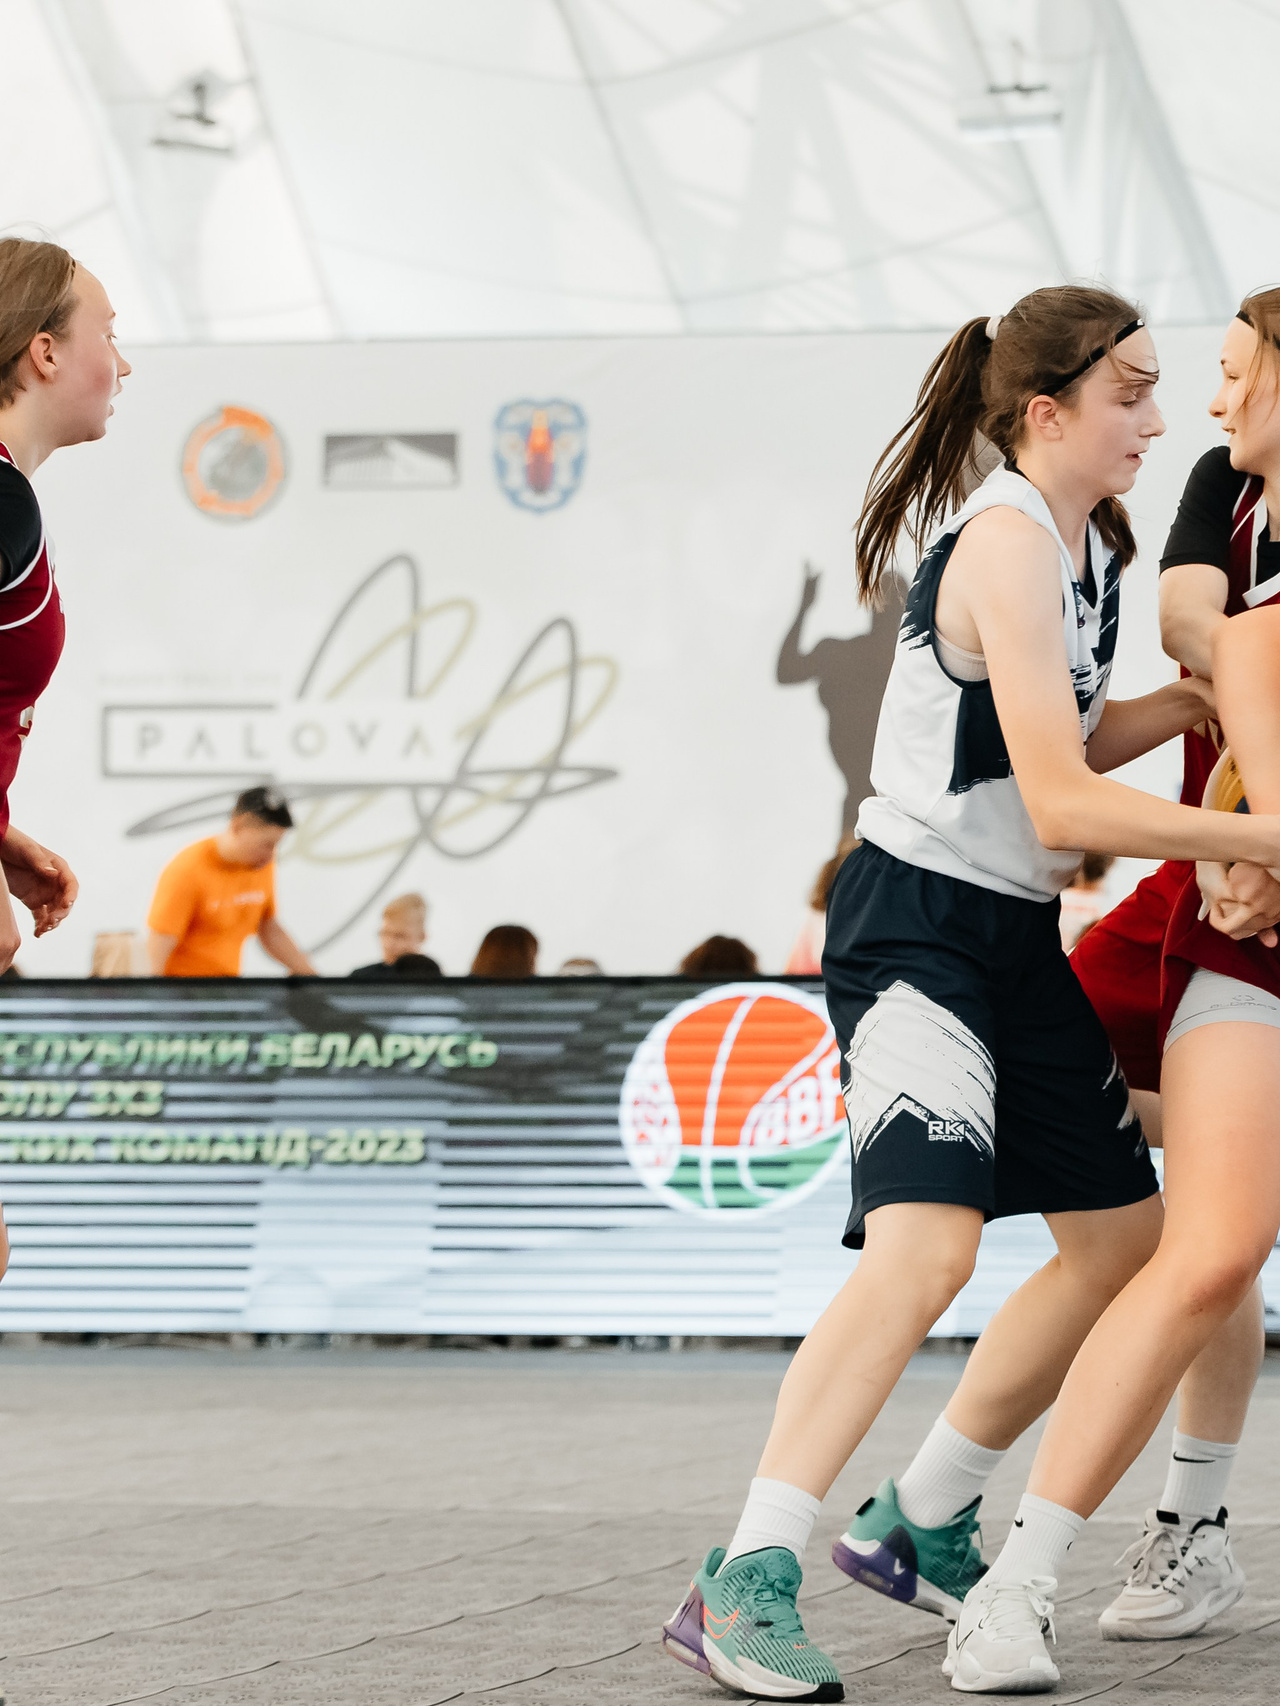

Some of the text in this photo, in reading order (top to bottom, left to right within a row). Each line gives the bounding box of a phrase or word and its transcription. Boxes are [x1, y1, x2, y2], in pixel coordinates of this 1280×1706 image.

[0, 1032, 499, 1070] СПУБЛИКИ БЕЛАРУСЬ
[928, 1134, 965, 1142] SPORT
